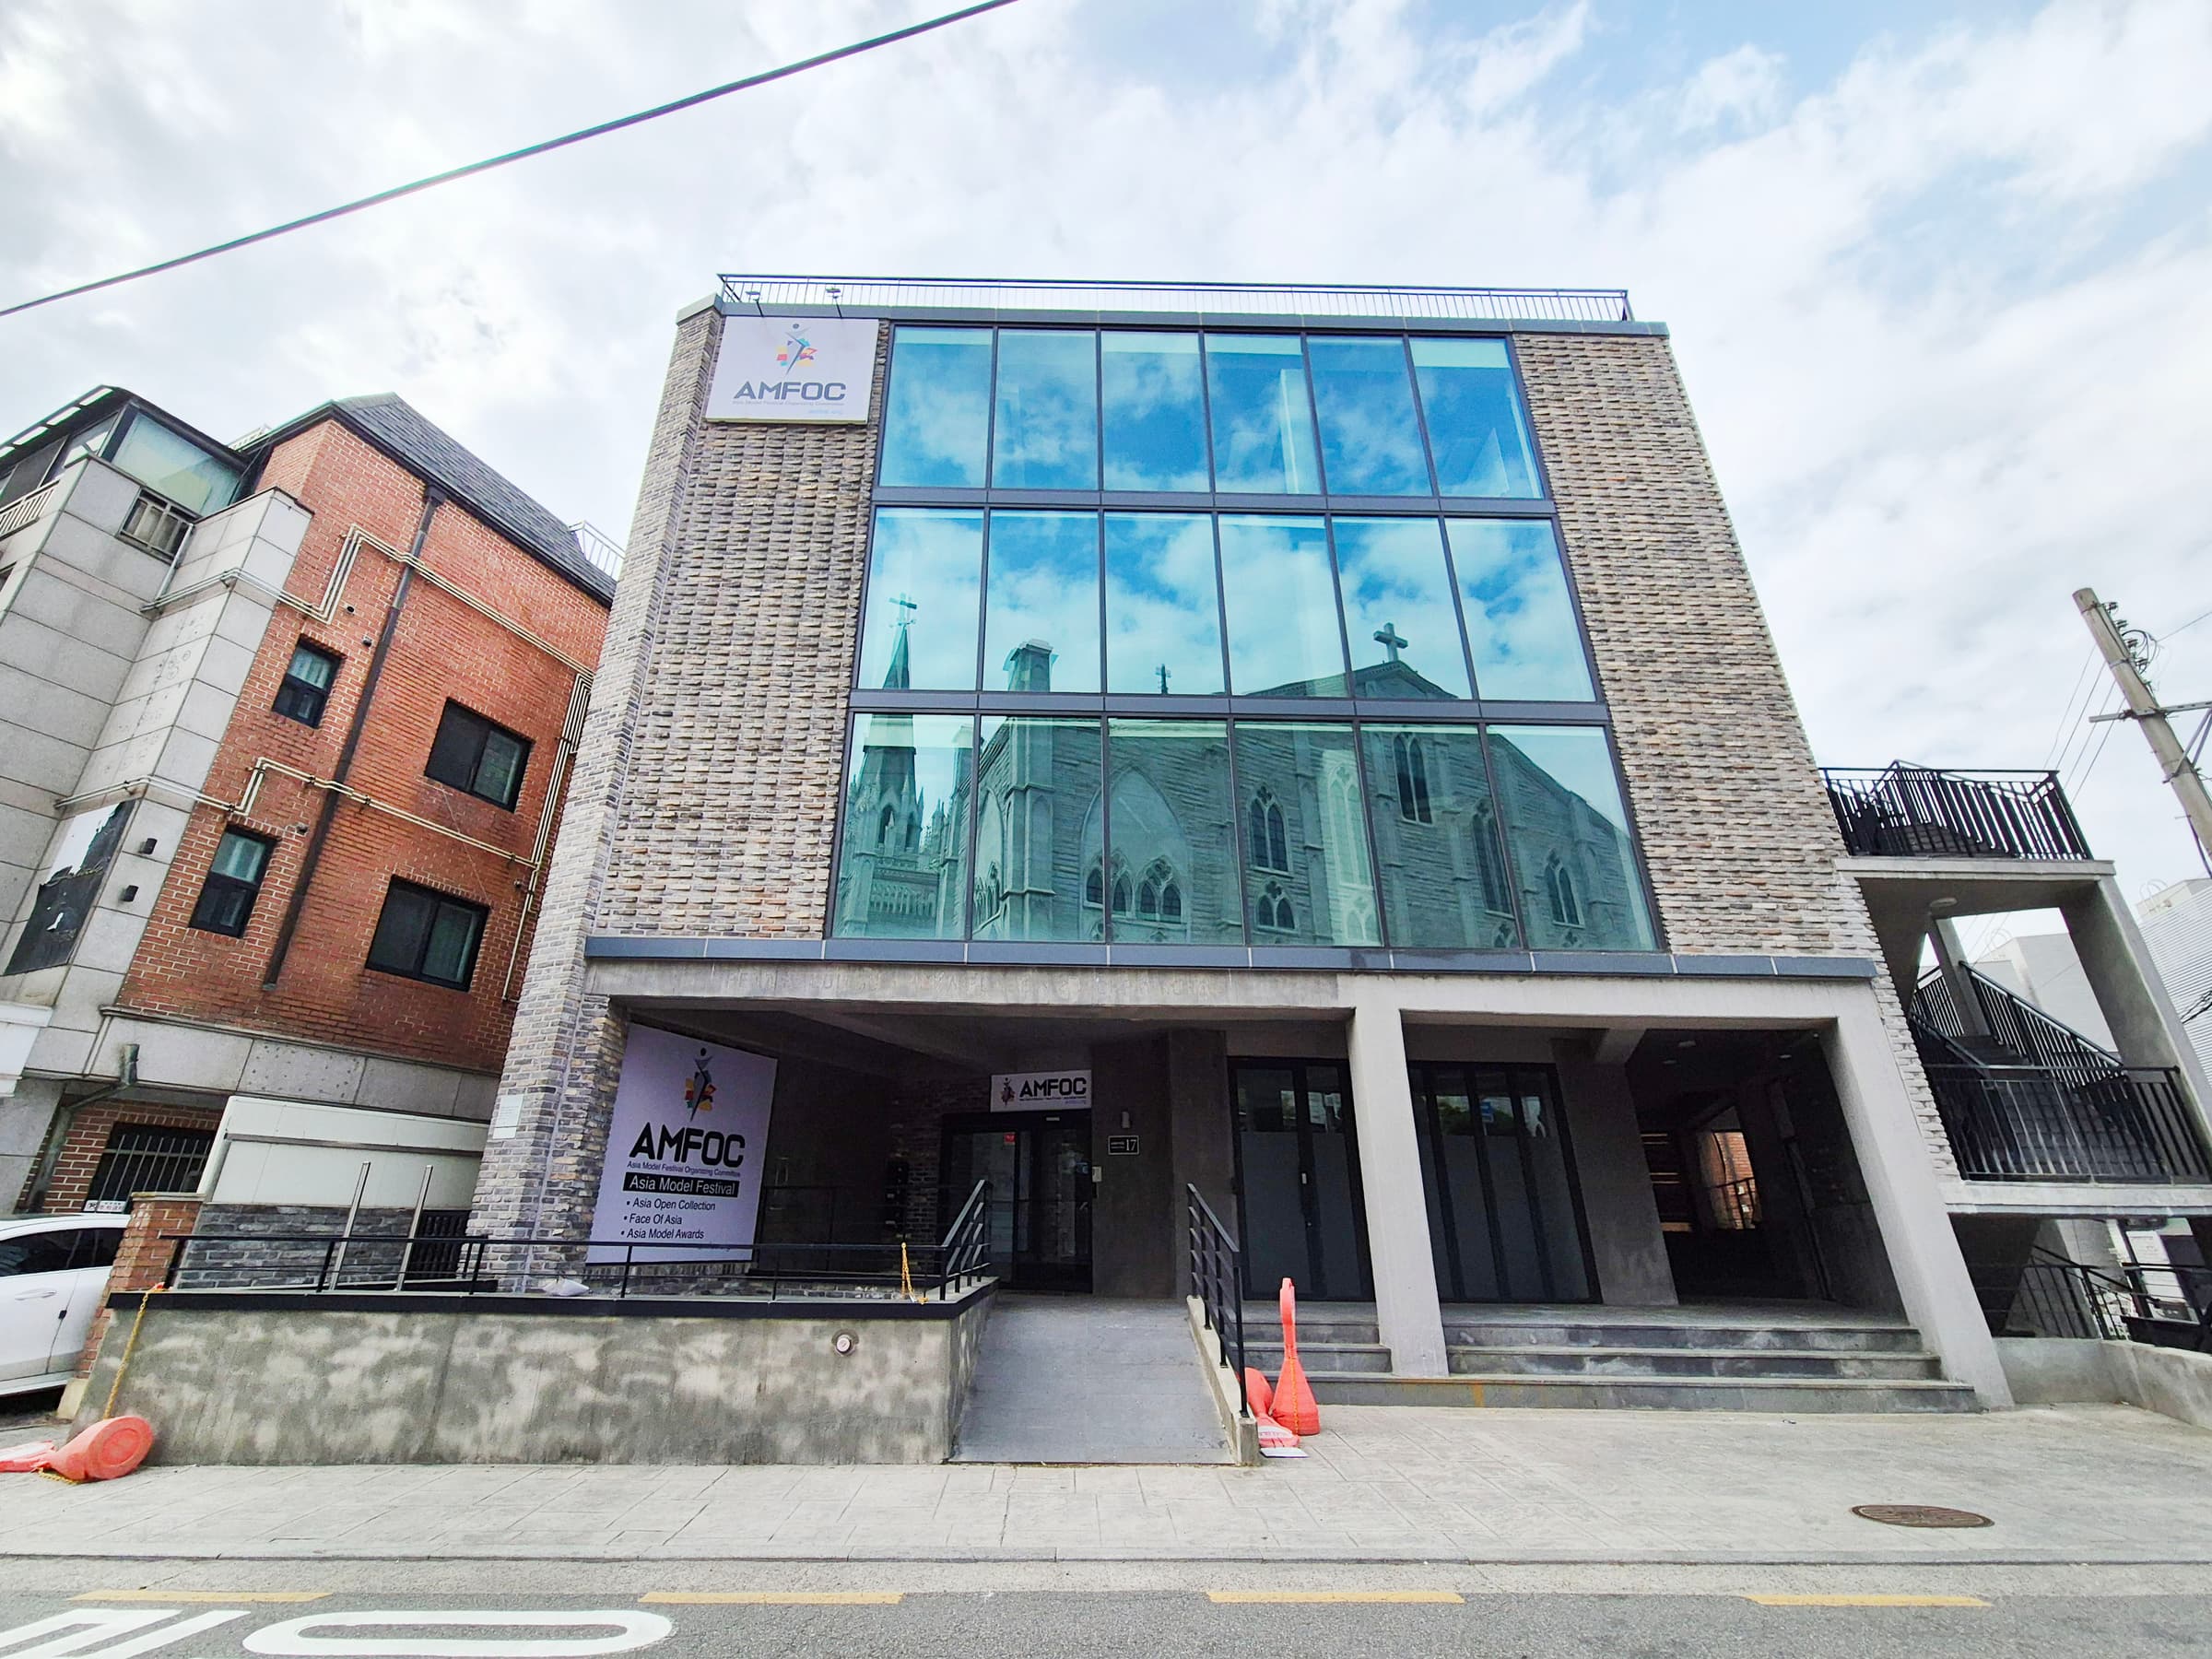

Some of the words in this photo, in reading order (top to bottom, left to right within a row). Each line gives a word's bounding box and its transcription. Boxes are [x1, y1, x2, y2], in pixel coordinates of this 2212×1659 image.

[734, 381, 847, 401] AMFOC
[1019, 1077, 1087, 1098] AMFOC
[629, 1122, 746, 1168] AMFOC
[1126, 1138, 1137, 1151] 17
[629, 1174, 656, 1190] Asia
[659, 1177, 694, 1192] Model
[696, 1180, 735, 1195] Festival
[632, 1197, 652, 1208] Asia
[653, 1197, 677, 1210] Open
[678, 1199, 716, 1211] Collection
[629, 1213, 651, 1224] Face
[653, 1214, 664, 1225] Of
[664, 1215, 683, 1225] Asia
[627, 1228, 646, 1239] Asia
[648, 1228, 675, 1239] Model
[675, 1229, 705, 1240] Awards
